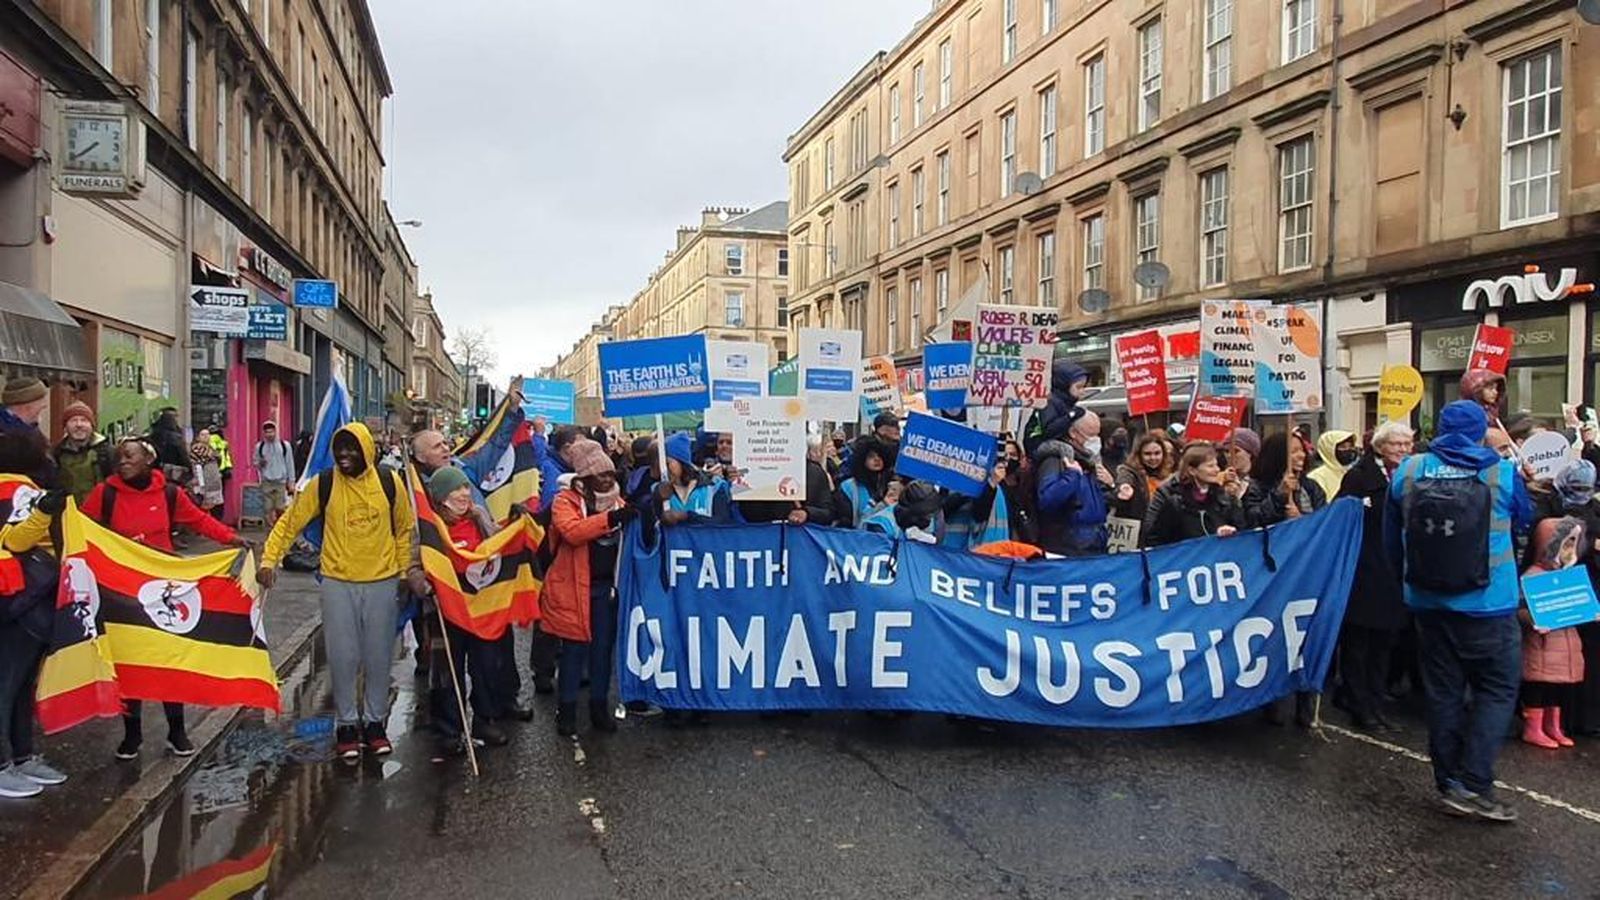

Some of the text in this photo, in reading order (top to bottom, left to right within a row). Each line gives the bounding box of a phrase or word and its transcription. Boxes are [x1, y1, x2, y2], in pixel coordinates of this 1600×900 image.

[64, 176, 122, 188] FUNERALS
[304, 282, 326, 293] OFF
[204, 292, 245, 307] shops
[300, 293, 332, 305] SALES
[254, 313, 285, 324] LET
[980, 310, 1058, 326] ROSES R DEAD
[978, 326, 1034, 344] VIOLETS
[1214, 326, 1250, 335] CLIMAT
[1281, 336, 1293, 345] UP
[1437, 335, 1465, 348] 0141
[1512, 330, 1556, 345] UNISEX
[1213, 342, 1254, 351] FINANC
[976, 356, 1046, 371] CHANGE IS
[1213, 359, 1255, 367] LEGALLY
[1278, 354, 1296, 363] FOR
[606, 363, 688, 383] THE EARTH IS
[929, 365, 947, 378] WE
[608, 382, 638, 393] GREEN
[638, 380, 657, 391] AND
[658, 375, 704, 388] BEAUTIFUL
[1282, 390, 1295, 399] UP
[1196, 401, 1237, 413] Climat
[1194, 413, 1231, 426] Justice
[908, 432, 975, 463] WE DEMAND
[903, 446, 946, 467] CLIMATE
[1108, 524, 1136, 540] HAT
[670, 548, 1248, 622] FAITH AND BELIEFS FOR
[626, 599, 1318, 708] CLIMATE JUSTICE
